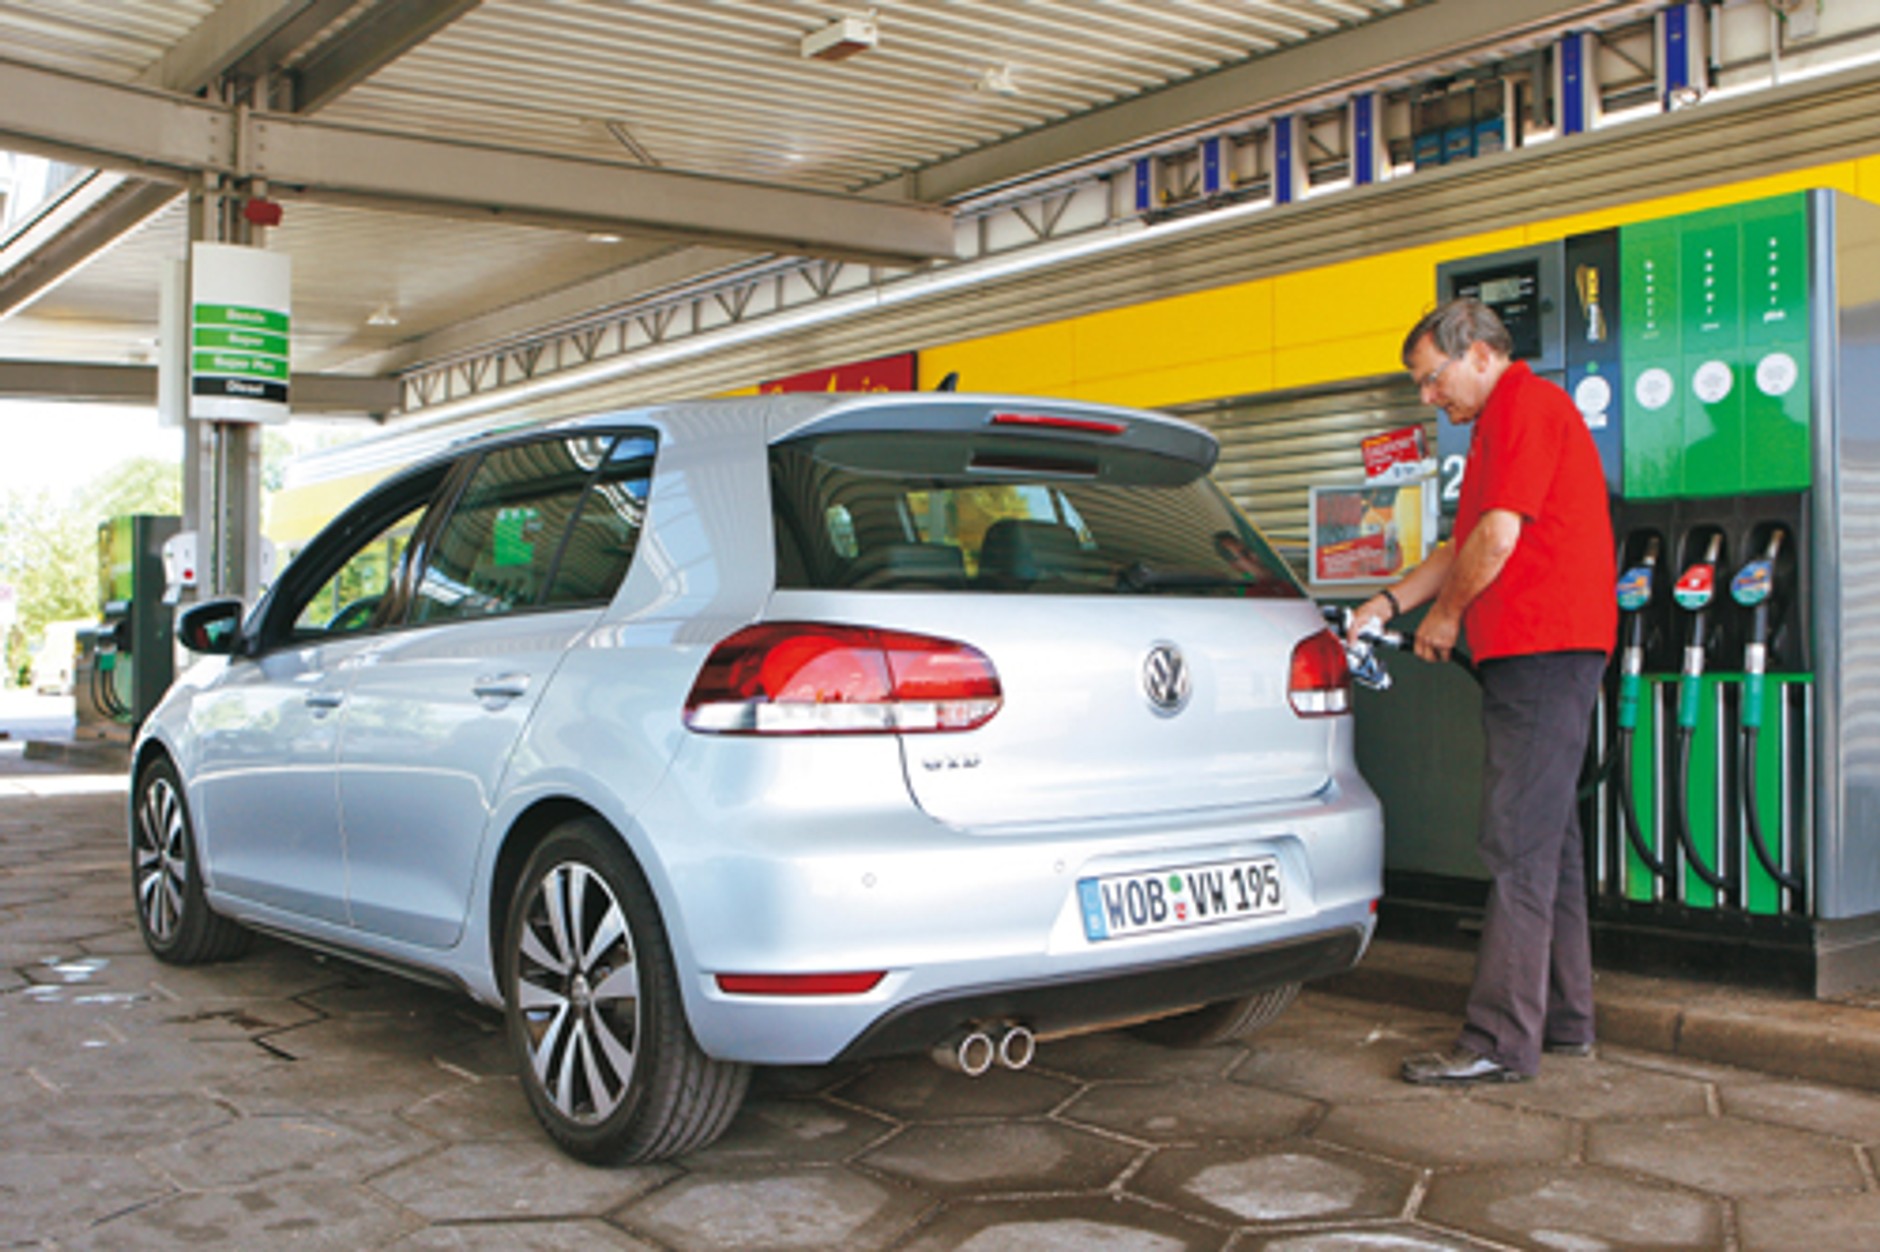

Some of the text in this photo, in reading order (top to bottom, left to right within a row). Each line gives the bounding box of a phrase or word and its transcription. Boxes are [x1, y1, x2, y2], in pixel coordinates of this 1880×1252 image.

[1443, 454, 1465, 498] 2
[1102, 864, 1280, 928] WOB VW 195
